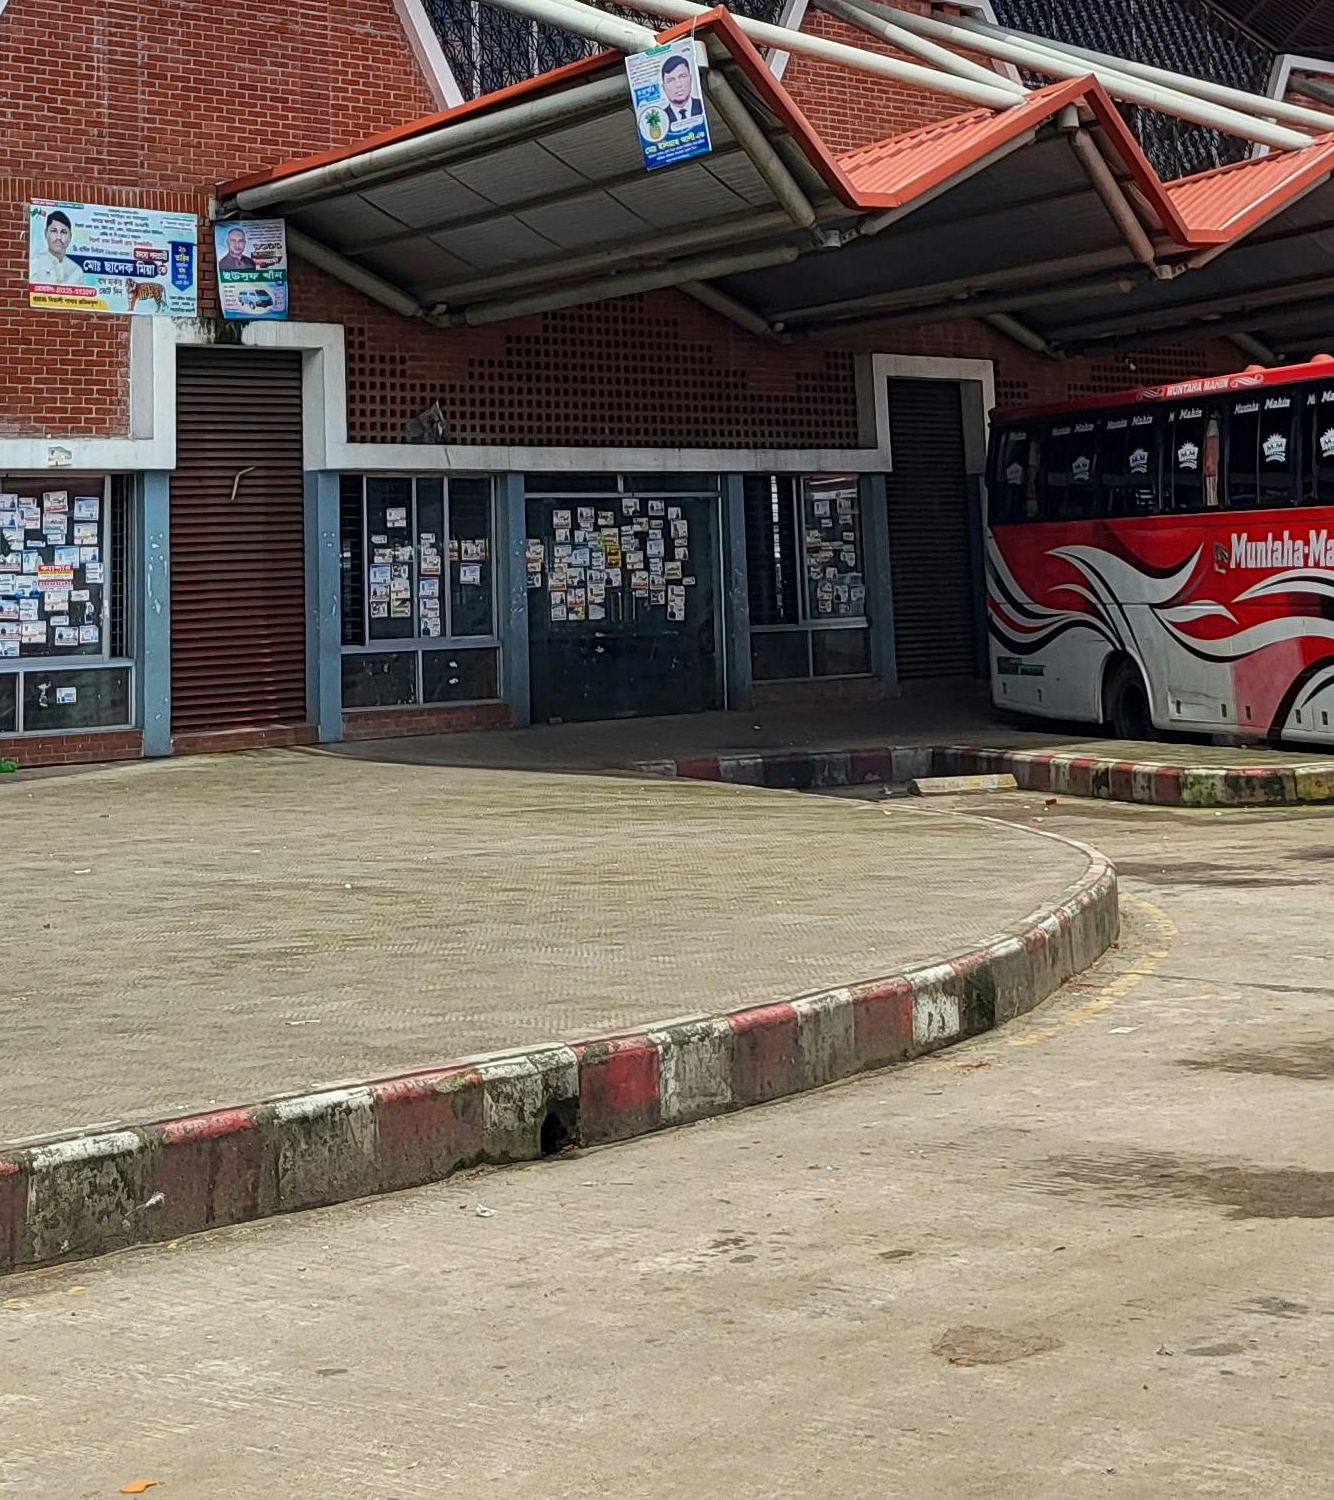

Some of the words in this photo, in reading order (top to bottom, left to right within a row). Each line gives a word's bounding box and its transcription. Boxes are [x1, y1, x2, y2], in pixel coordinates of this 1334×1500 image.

[83, 259, 101, 272] মোঃ
[104, 260, 135, 275] ছাদেক
[136, 260, 156, 277] মিয়া
[1166, 382, 1203, 397] MUNTAHA
[1203, 378, 1229, 391] MAHIN
[1264, 397, 1291, 410] Mahin
